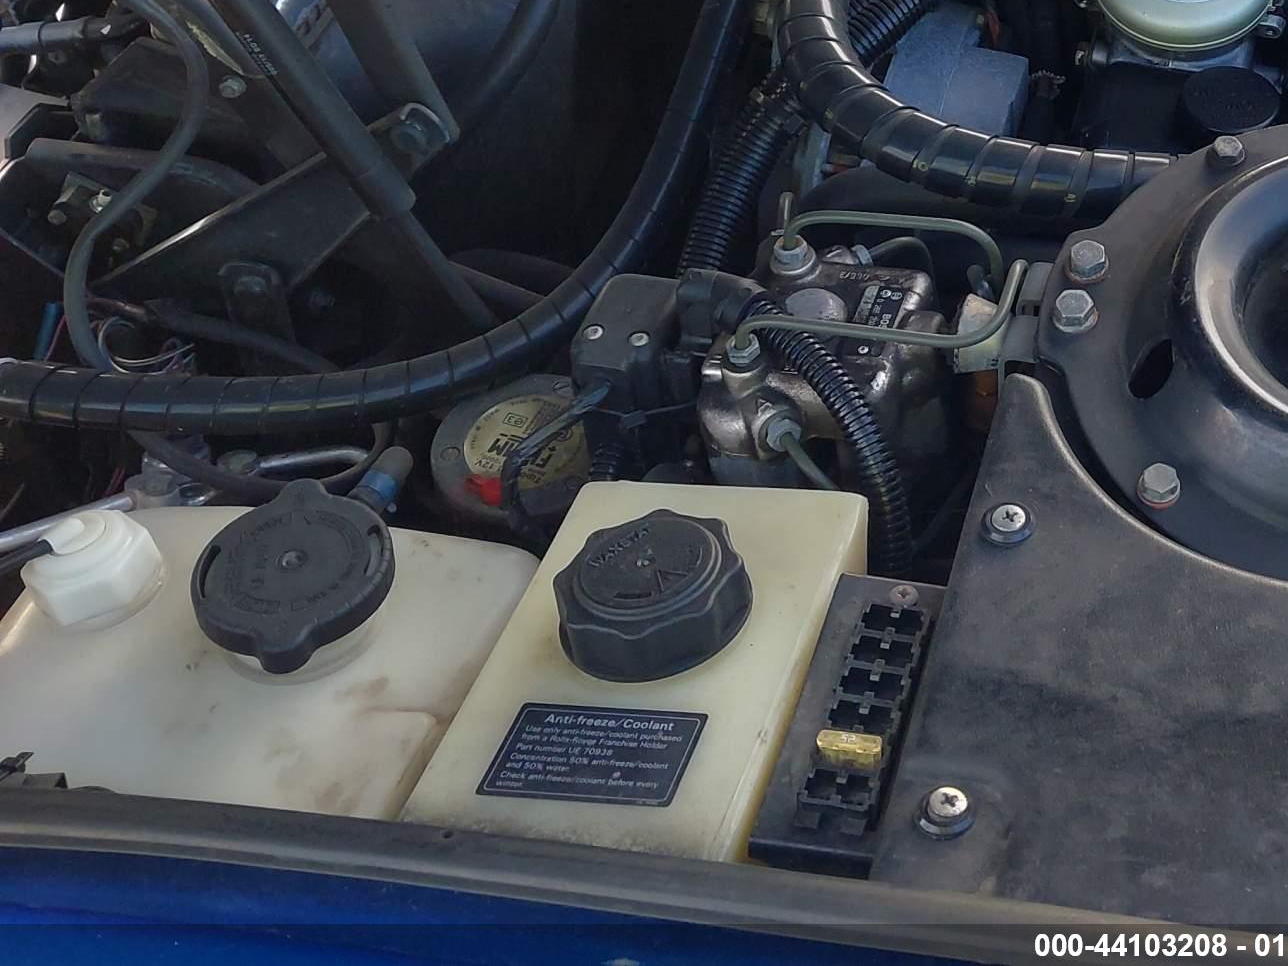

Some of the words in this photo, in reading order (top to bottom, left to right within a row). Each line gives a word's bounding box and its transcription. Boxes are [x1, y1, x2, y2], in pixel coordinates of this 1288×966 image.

[543, 713, 676, 732] Anti-freeze/Coolant
[521, 732, 539, 743] from
[598, 737, 639, 749] Franchise
[639, 739, 669, 750] Holder
[525, 724, 542, 734] Use
[541, 726, 561, 737] only
[562, 727, 639, 740] anti-freeze/coolant
[639, 731, 683, 744] purchased
[515, 742, 534, 752] Part
[535, 743, 567, 754] number
[505, 760, 523, 770] and
[509, 752, 567, 764] Concentration
[568, 754, 590, 765] 50%
[500, 769, 526, 780] Check
[607, 775, 635, 787] before
[635, 779, 660, 791] every
